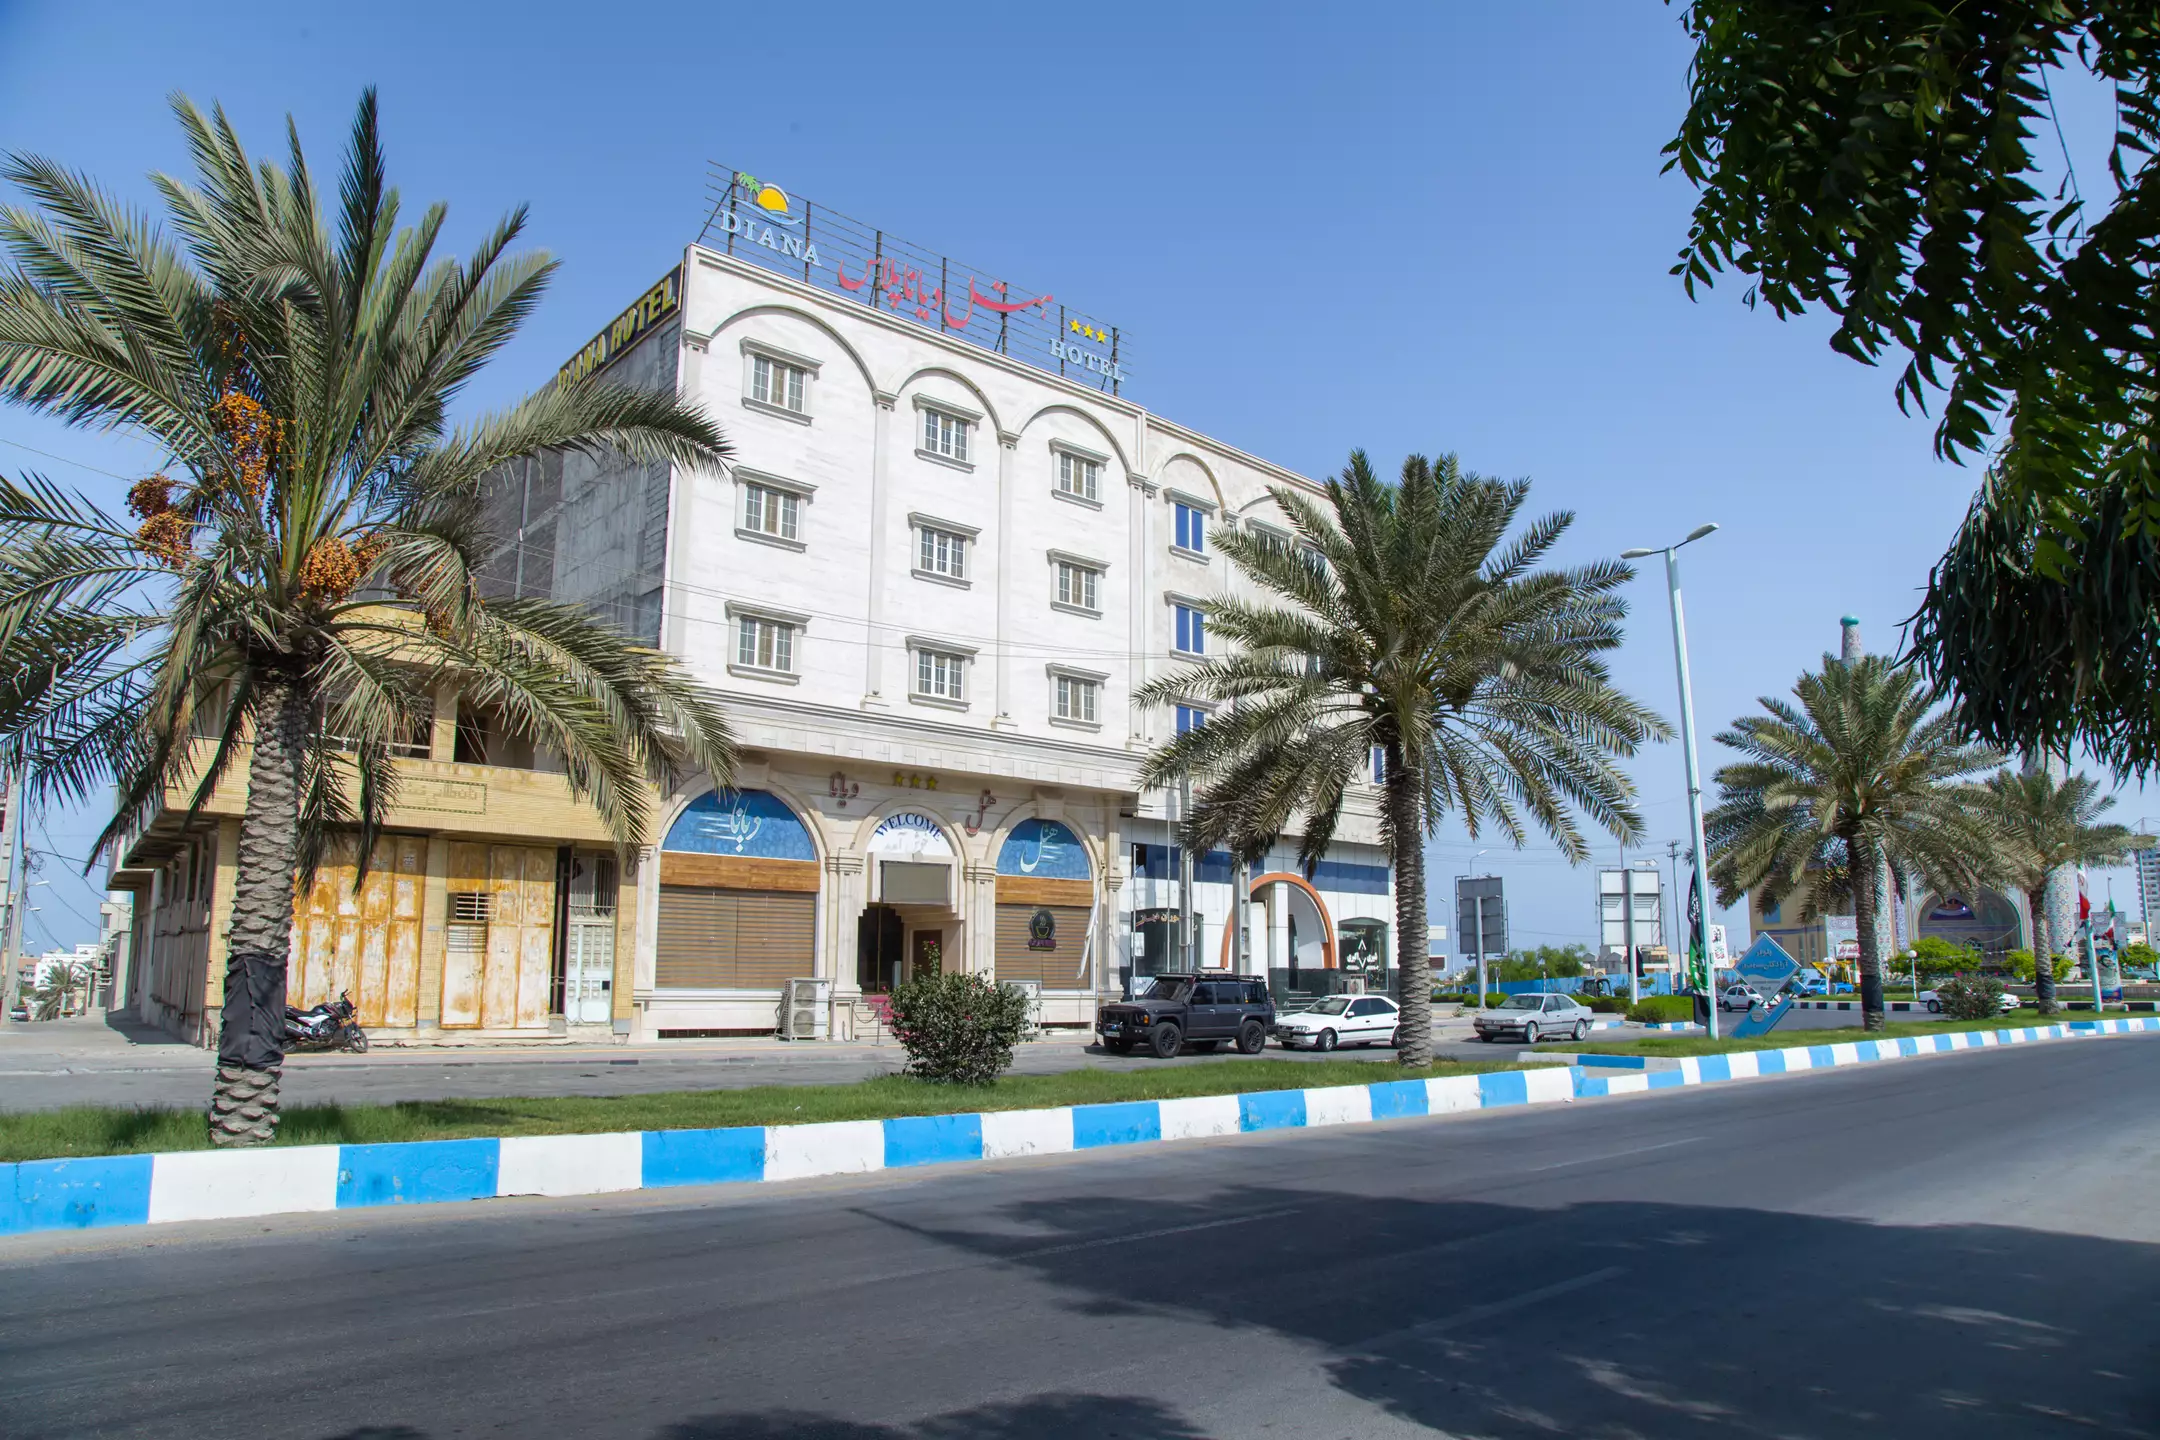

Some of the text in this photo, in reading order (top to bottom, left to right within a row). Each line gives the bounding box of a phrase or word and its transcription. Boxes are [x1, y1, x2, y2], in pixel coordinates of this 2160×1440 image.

[720, 210, 822, 267] DIANA
[838, 257, 1054, 329] هتل دیانا پلاس
[557, 276, 677, 393] DIANA HOTEL
[1049, 338, 1125, 383] HOTEL
[730, 793, 762, 853] دیانا
[829, 771, 997, 837] هتل دیانا
[875, 812, 941, 842] WELCOME
[1020, 823, 1059, 873] هتل
